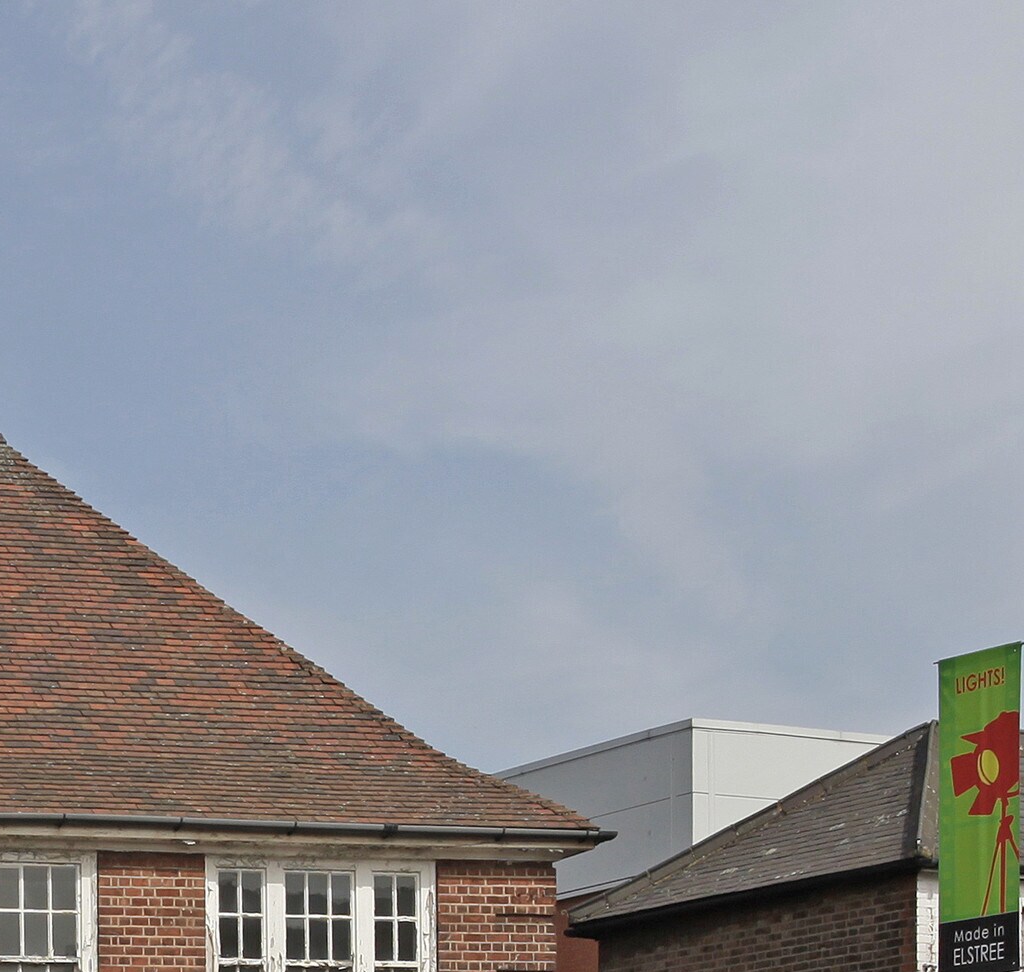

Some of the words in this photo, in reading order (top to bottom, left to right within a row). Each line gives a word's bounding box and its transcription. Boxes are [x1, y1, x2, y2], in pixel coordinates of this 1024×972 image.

[956, 667, 1004, 694] LIGHTS!
[954, 926, 989, 943] Made
[993, 923, 1005, 937] in
[953, 942, 1005, 966] ELSTREE
